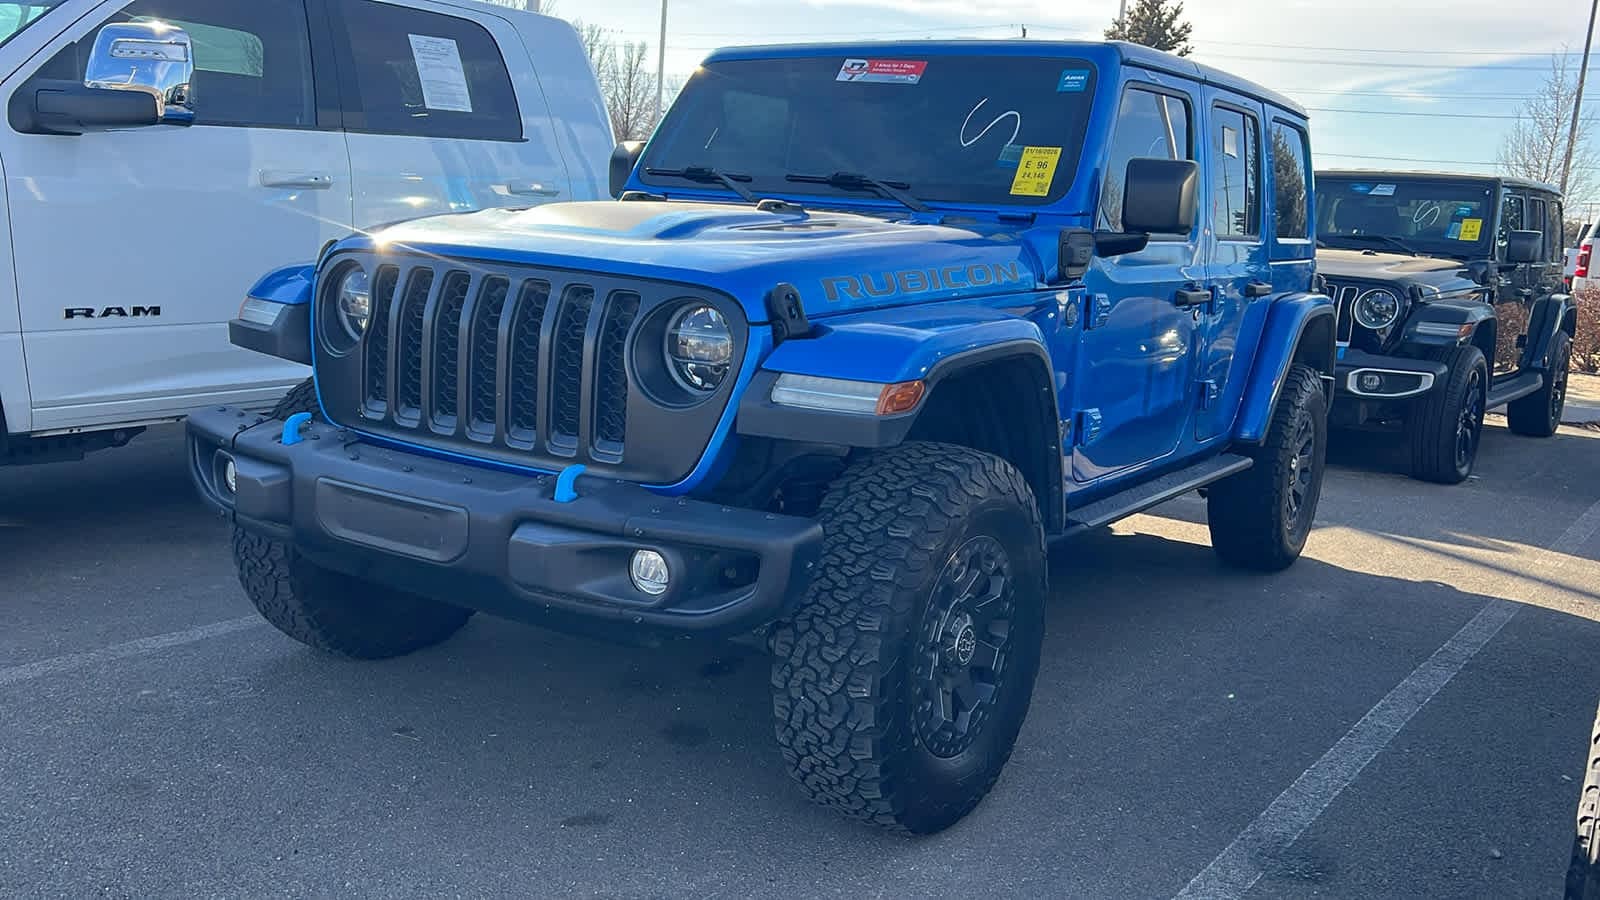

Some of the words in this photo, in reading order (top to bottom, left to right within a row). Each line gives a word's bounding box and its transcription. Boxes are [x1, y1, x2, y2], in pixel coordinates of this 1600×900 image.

[1025, 160, 1032, 169] E
[1036, 160, 1049, 170] 96
[821, 261, 1020, 301] RUBICON
[64, 305, 161, 319] RAM
